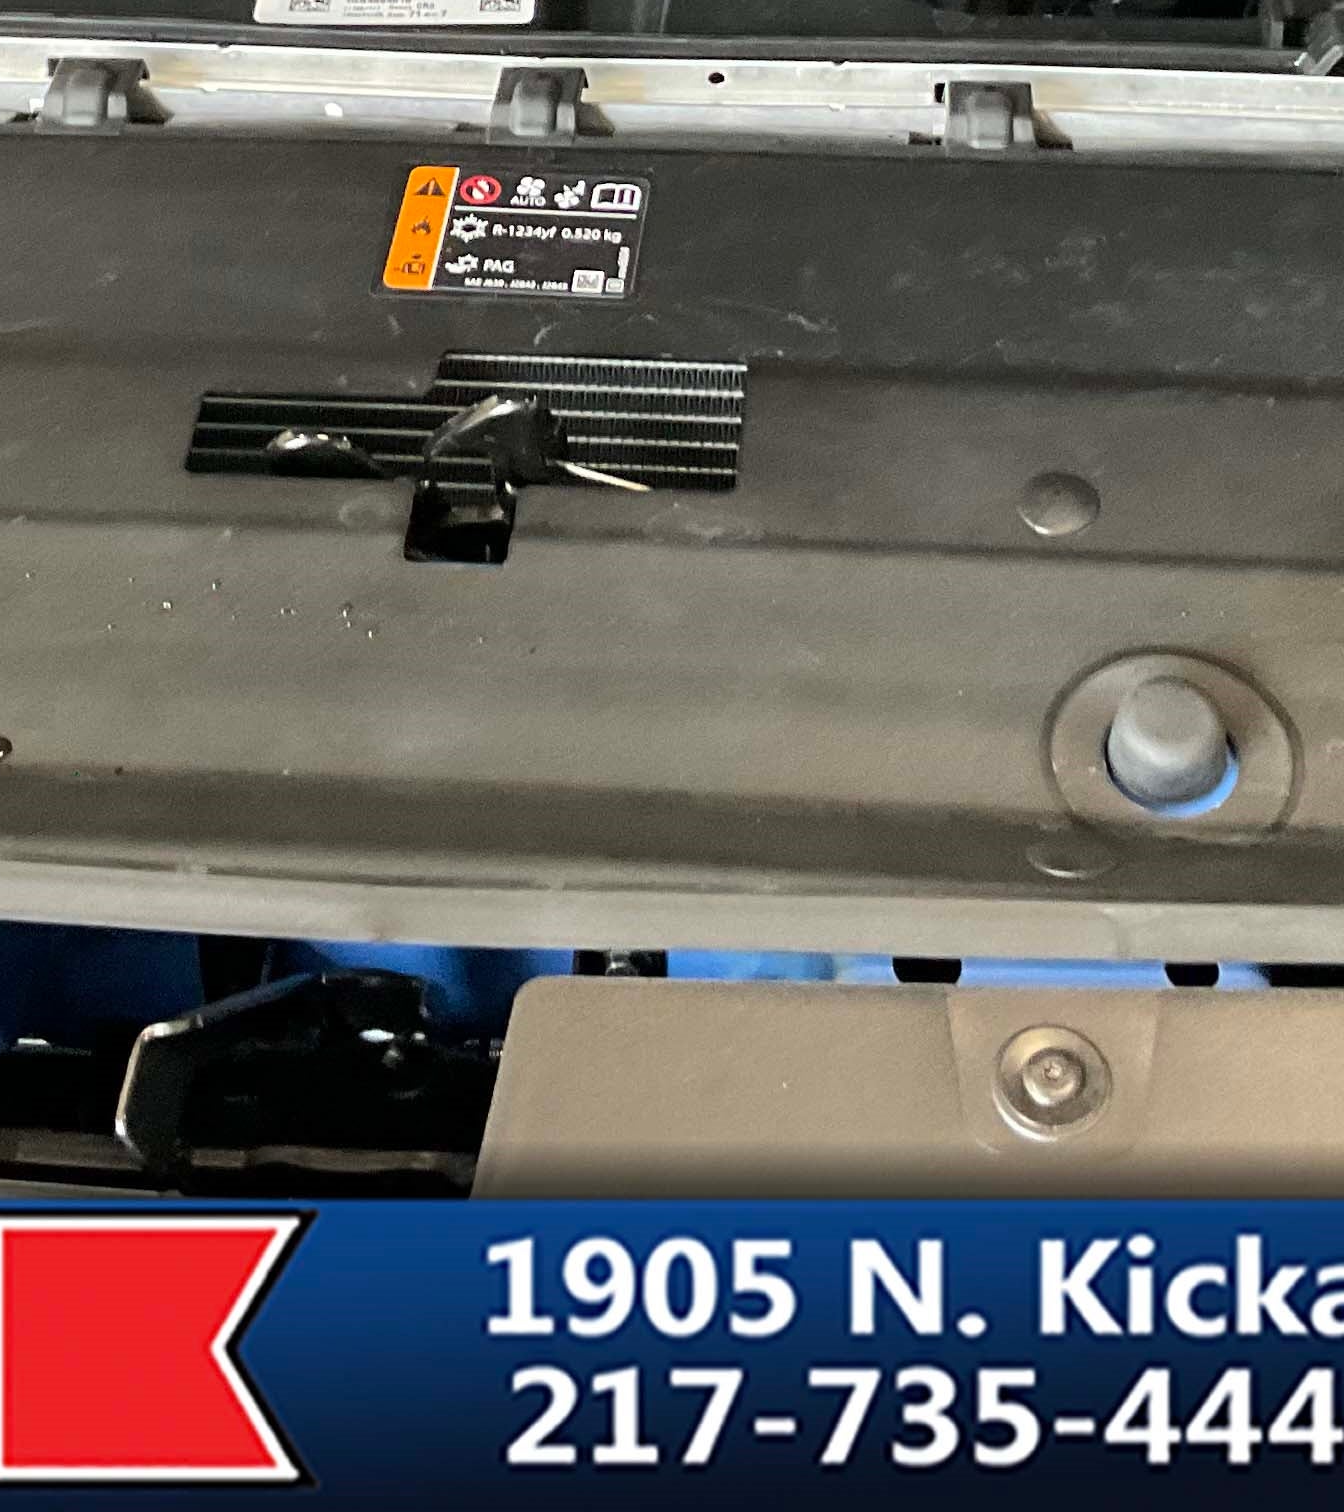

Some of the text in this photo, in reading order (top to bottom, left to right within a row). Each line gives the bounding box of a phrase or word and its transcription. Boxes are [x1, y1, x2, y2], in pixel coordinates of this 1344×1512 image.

[510, 195, 546, 207] AUTO
[492, 223, 557, 240] R-1234yf
[603, 229, 623, 244] kg
[483, 258, 515, 274] PAG
